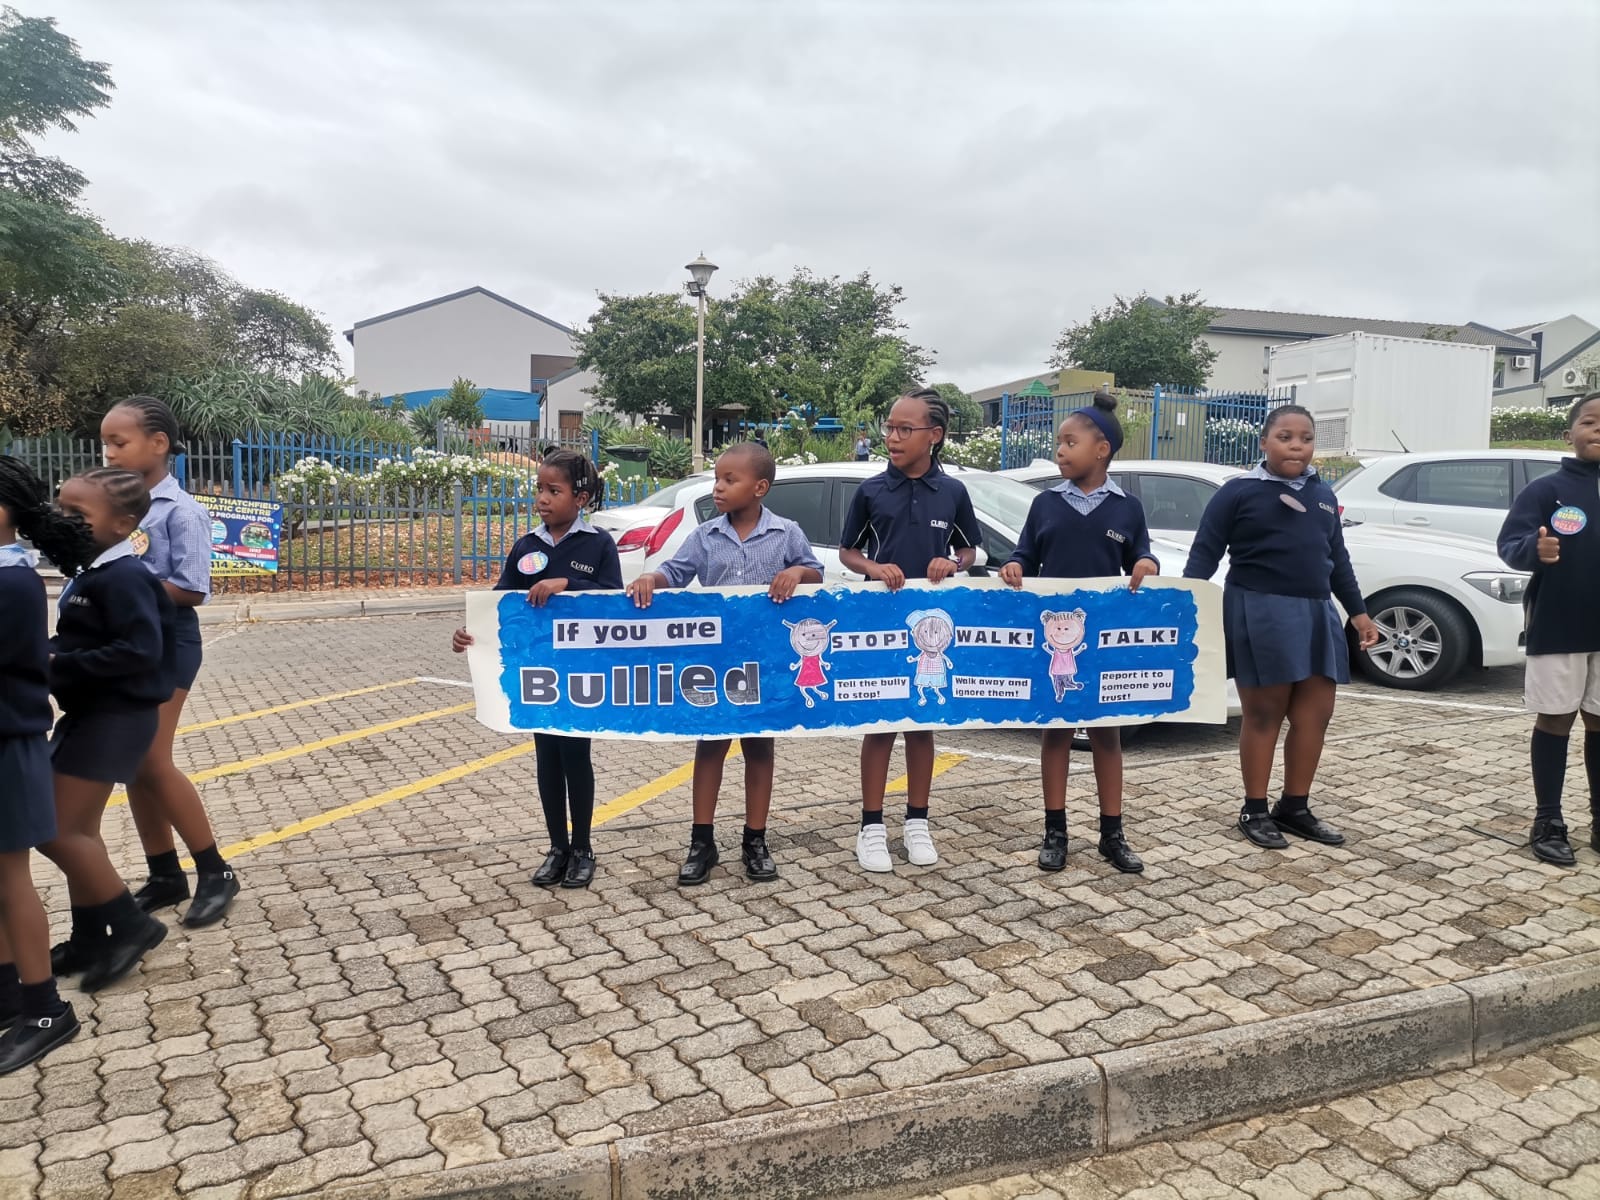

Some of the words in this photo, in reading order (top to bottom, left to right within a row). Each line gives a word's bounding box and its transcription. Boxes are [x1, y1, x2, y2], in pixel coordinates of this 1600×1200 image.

[219, 497, 280, 511] THATCHFIELD
[235, 505, 271, 517] CENTRE
[216, 511, 256, 522] PROGRAMS
[257, 516, 274, 524] FOR:
[570, 560, 594, 574] CURRO
[557, 622, 579, 642] If
[593, 624, 647, 644] you
[667, 621, 716, 639] are
[956, 629, 1034, 646] WALK!
[1100, 629, 1177, 646] TALK!
[831, 632, 908, 649] STOP!
[1102, 671, 1137, 682] Report
[1140, 671, 1149, 679] it
[1151, 670, 1163, 679] to
[520, 662, 761, 707] Bullied
[837, 680, 856, 688] Tell
[859, 679, 878, 687] the
[880, 677, 906, 687] bully
[955, 677, 977, 686] Walk
[978, 678, 1005, 688] away
[1008, 678, 1028, 687] and
[1102, 681, 1150, 691] someone
[1152, 681, 1172, 691] you
[837, 691, 849, 699] to
[852, 690, 880, 700] stop!
[955, 688, 985, 698] ignore
[987, 688, 1019, 698] them!
[1102, 693, 1131, 702] trust!
